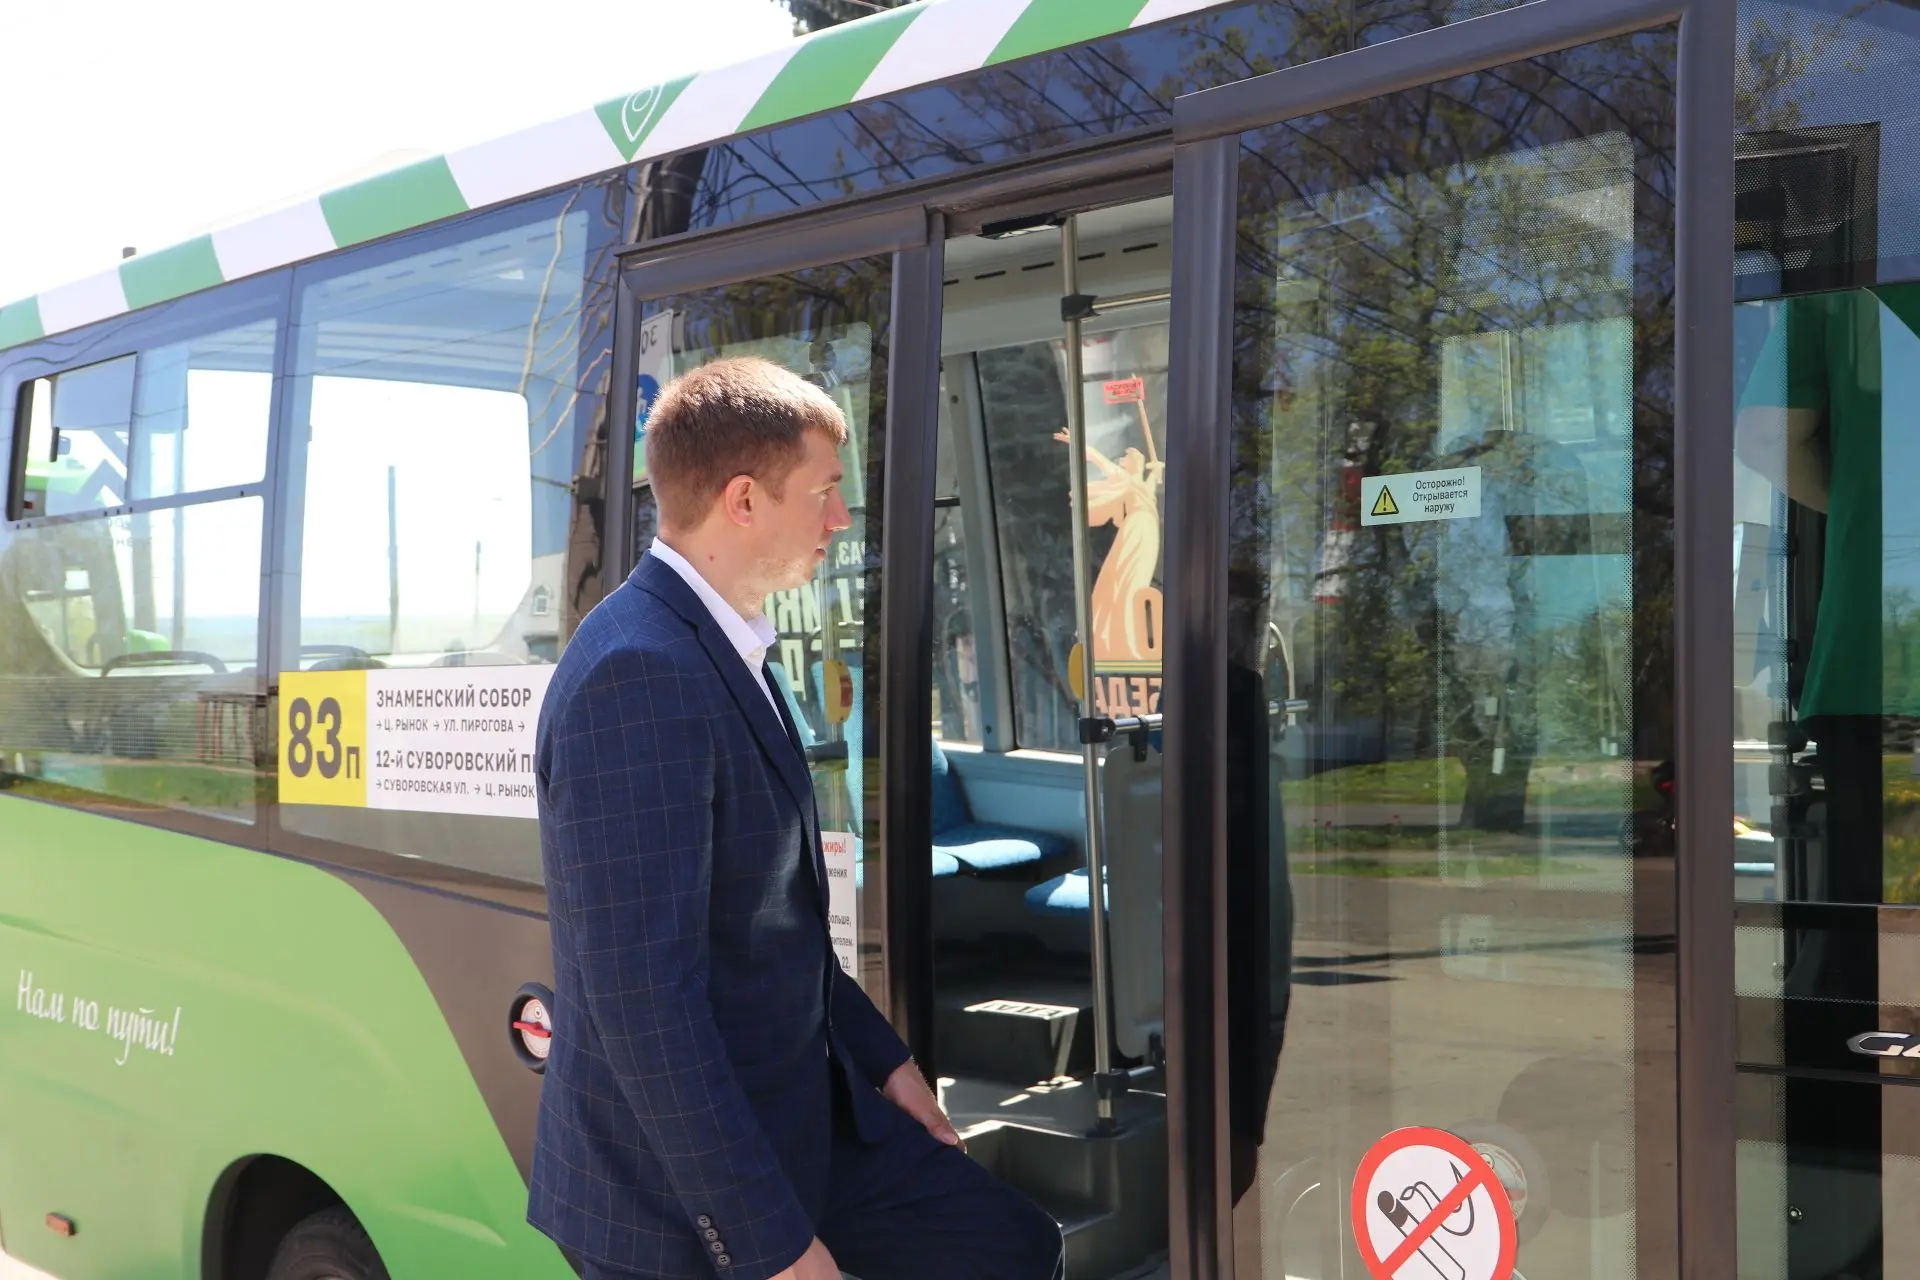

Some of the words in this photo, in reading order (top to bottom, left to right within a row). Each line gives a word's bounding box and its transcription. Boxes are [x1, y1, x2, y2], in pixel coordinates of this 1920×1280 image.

[1415, 476, 1465, 490] Осторожно!
[1412, 489, 1468, 502] Открывается
[1424, 503, 1455, 514] наружу
[376, 684, 475, 708] ЗНАМЕНСКИЙ
[479, 687, 532, 707] СОБОР
[384, 720, 394, 733] Ц.
[396, 720, 428, 731] РЫНОК
[443, 719, 459, 732] УЛ.
[461, 719, 513, 732] ПИРОГОВА
[376, 750, 403, 768] 12-й
[406, 749, 516, 773] СУВОРОВСКИЙ
[384, 779, 452, 794] СУВОРОВСКАЯ
[455, 782, 469, 794] УЛ.
[485, 784, 495, 798] Ц.
[499, 784, 535, 798] РЫНОК
[17, 968, 65, 1023] Нам
[72, 996, 99, 1030] по
[106, 1006, 182, 1066] пути!
